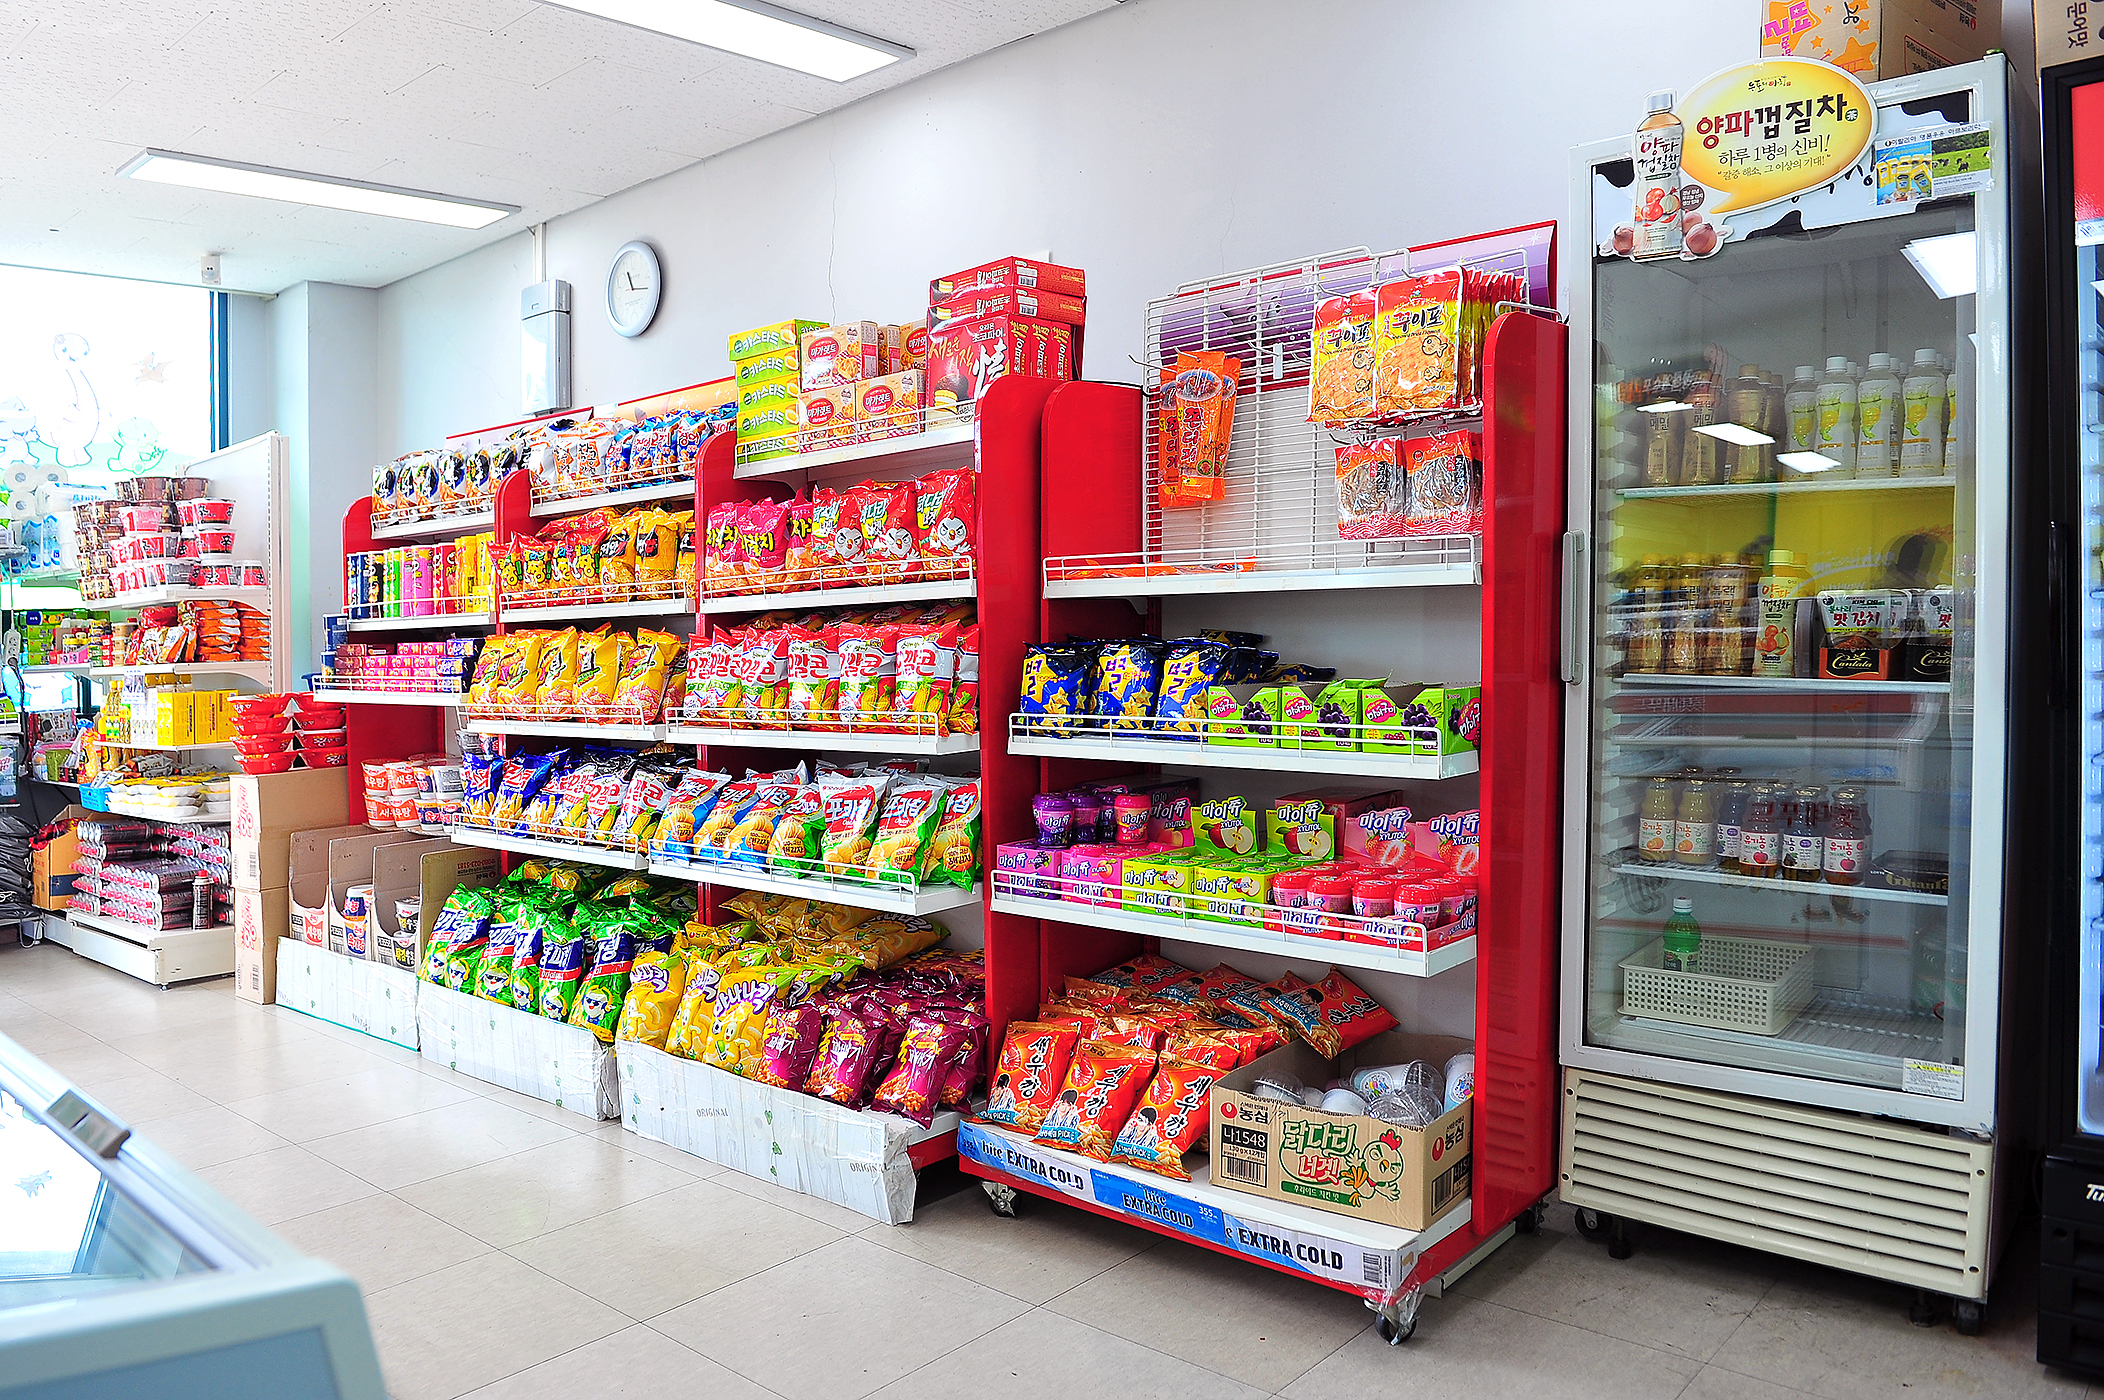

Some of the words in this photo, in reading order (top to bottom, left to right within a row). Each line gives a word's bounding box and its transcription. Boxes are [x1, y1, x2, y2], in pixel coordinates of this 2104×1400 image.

[1696, 93, 1848, 150] 양파껍질차
[1718, 144, 1751, 167] 하루
[1753, 142, 1788, 163] 1병의
[1790, 134, 1831, 157] 신비!
[1775, 158, 1802, 172] 이상의
[1392, 304, 1444, 333] 꾸이포
[743, 331, 780, 352] 카스타드
[1327, 321, 1373, 349] 꾸이포
[810, 344, 837, 358] 마가렛트
[750, 357, 784, 378] 카스타드
[752, 383, 786, 403] 카스타드
[864, 392, 893, 407] 마가렛트
[750, 410, 785, 430] 카스타드
[806, 405, 832, 419] 마가렛트
[1833, 613, 1848, 627] 맛
[1850, 611, 1881, 627] 김치
[1831, 654, 1873, 671] Cantata
[1211, 697, 1238, 715] 마이구미
[1285, 699, 1313, 718] 마이구미
[1366, 701, 1397, 721] 마이구미
[1122, 810, 1150, 827] 마이쮸
[1150, 799, 1190, 820] 마이쮸
[1202, 797, 1246, 820] 마이쮸
[1278, 801, 1323, 824] 마이쮸
[1044, 813, 1072, 828] 마이쮸
[1220, 819, 1244, 829] XYLITOL
[1297, 823, 1322, 832] XYLITOL
[1359, 808, 1411, 832] 마이쮸
[1430, 811, 1479, 835] 마이쮸
[1642, 821, 1663, 836] 유기농
[1378, 830, 1407, 842] XYLITOL
[1744, 834, 1767, 850] 유기농
[1829, 841, 1853, 856] 유기농
[999, 852, 1028, 870] 마이쮸
[1063, 860, 1091, 878] 마이쮸
[1124, 869, 1158, 886] 마이쮸
[1196, 876, 1231, 894] 마이쮸
[1017, 1035, 1054, 1099] 새우깡
[1084, 1062, 1133, 1120] 새우깡
[1163, 1074, 1213, 1139] 새우깡
[1239, 1108, 1269, 1125] 농심
[1223, 1127, 1267, 1148] 나1548
[1282, 1119, 1358, 1157] 닭다리
[1444, 1122, 1465, 1151] 농심
[981, 1140, 1003, 1160] hite
[1006, 1151, 1047, 1178] EXTRA
[1048, 1165, 1085, 1191] COLD
[1297, 1154, 1340, 1186] 너겟
[1143, 1187, 1167, 1206] hite
[1318, 1188, 1332, 1200] 치킨
[1332, 1190, 1341, 1202] 맛
[1122, 1192, 1160, 1218] EXTRA
[1160, 1207, 1194, 1229] COLD
[1237, 1226, 1293, 1260] EXTRA
[1295, 1242, 1343, 1272] COLD
